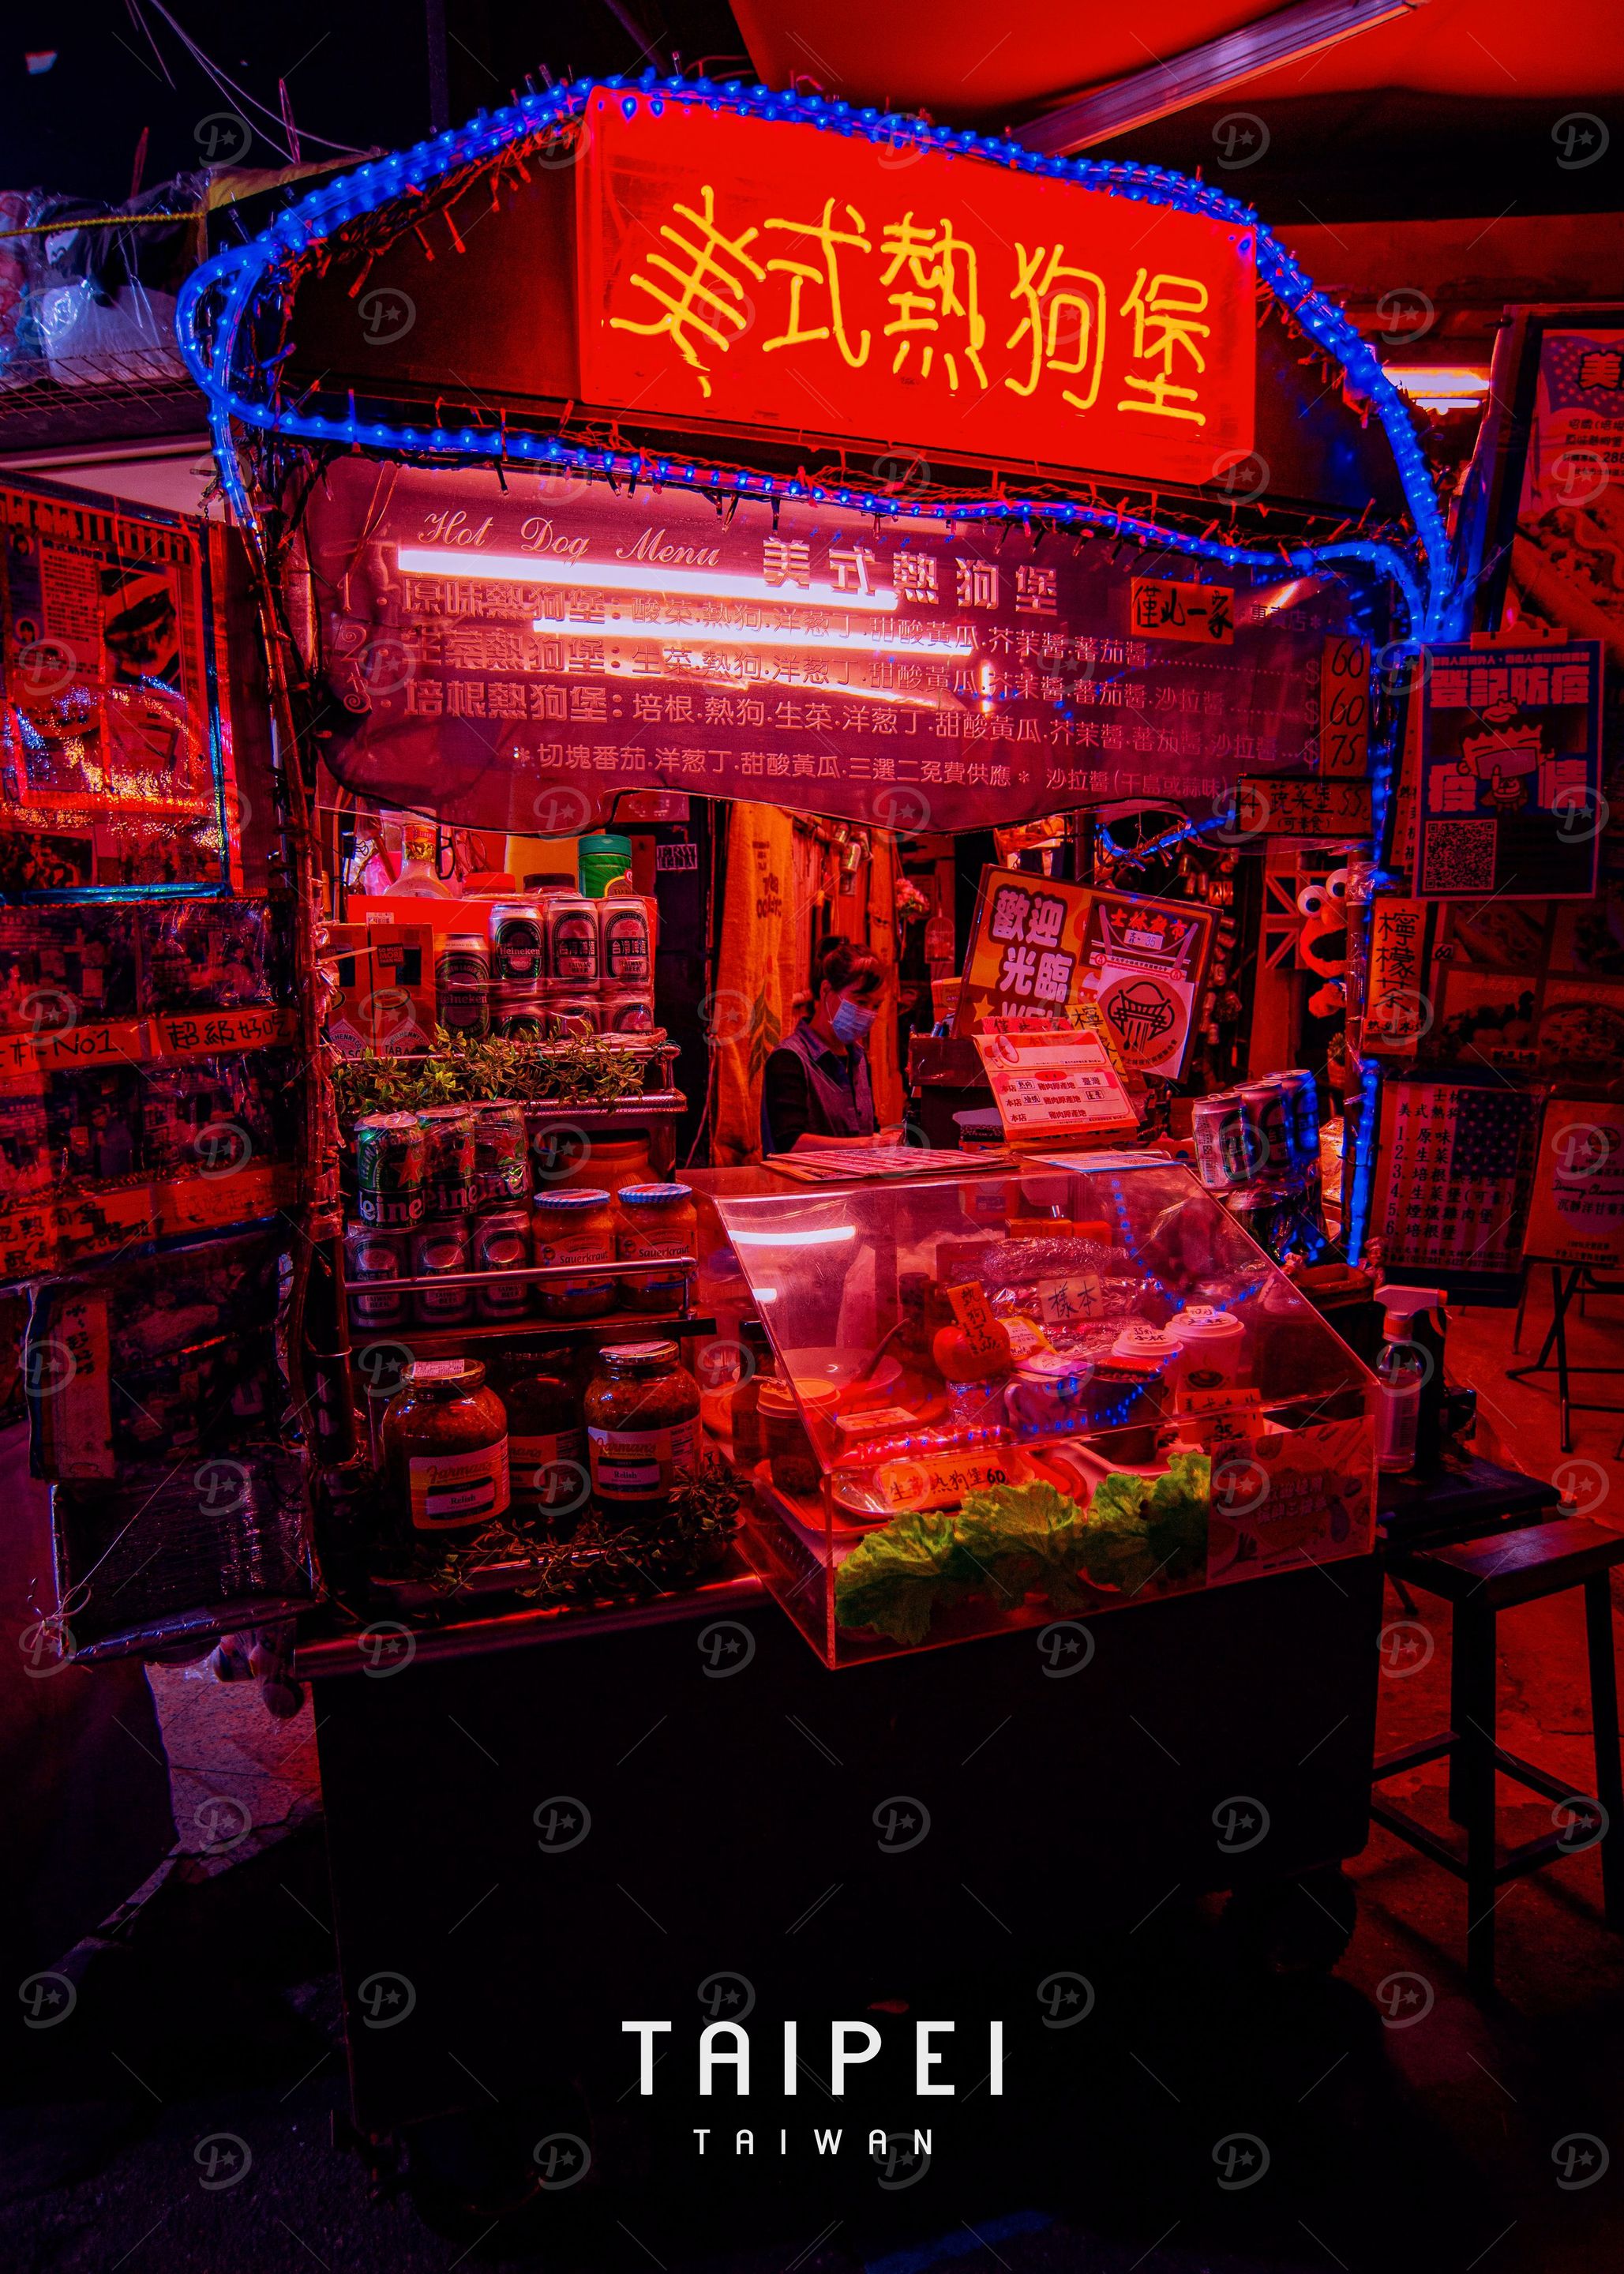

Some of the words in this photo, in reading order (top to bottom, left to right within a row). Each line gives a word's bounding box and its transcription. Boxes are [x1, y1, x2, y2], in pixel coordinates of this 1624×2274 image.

[609, 185, 1210, 426] 美式熱狗堡
[418, 509, 493, 547] Hot
[520, 516, 591, 566] Dog
[616, 526, 721, 568] Menu
[763, 535, 1058, 616] 美式熱狗堡
[1133, 583, 1233, 639] 僅此一家
[1331, 640, 1364, 679] 60
[1330, 688, 1365, 727] 60
[1330, 734, 1365, 768] 75
[991, 889, 1065, 948] 歡迎
[499, 946, 542, 957] Heineken
[999, 946, 1072, 1004] 光臨
[1373, 907, 1420, 1014] 檸檬茶
[559, 1250, 609, 1265] Sauerkraut
[638, 1244, 691, 1258] Sauerkraut
[1048, 1281, 1097, 1318] 樣本
